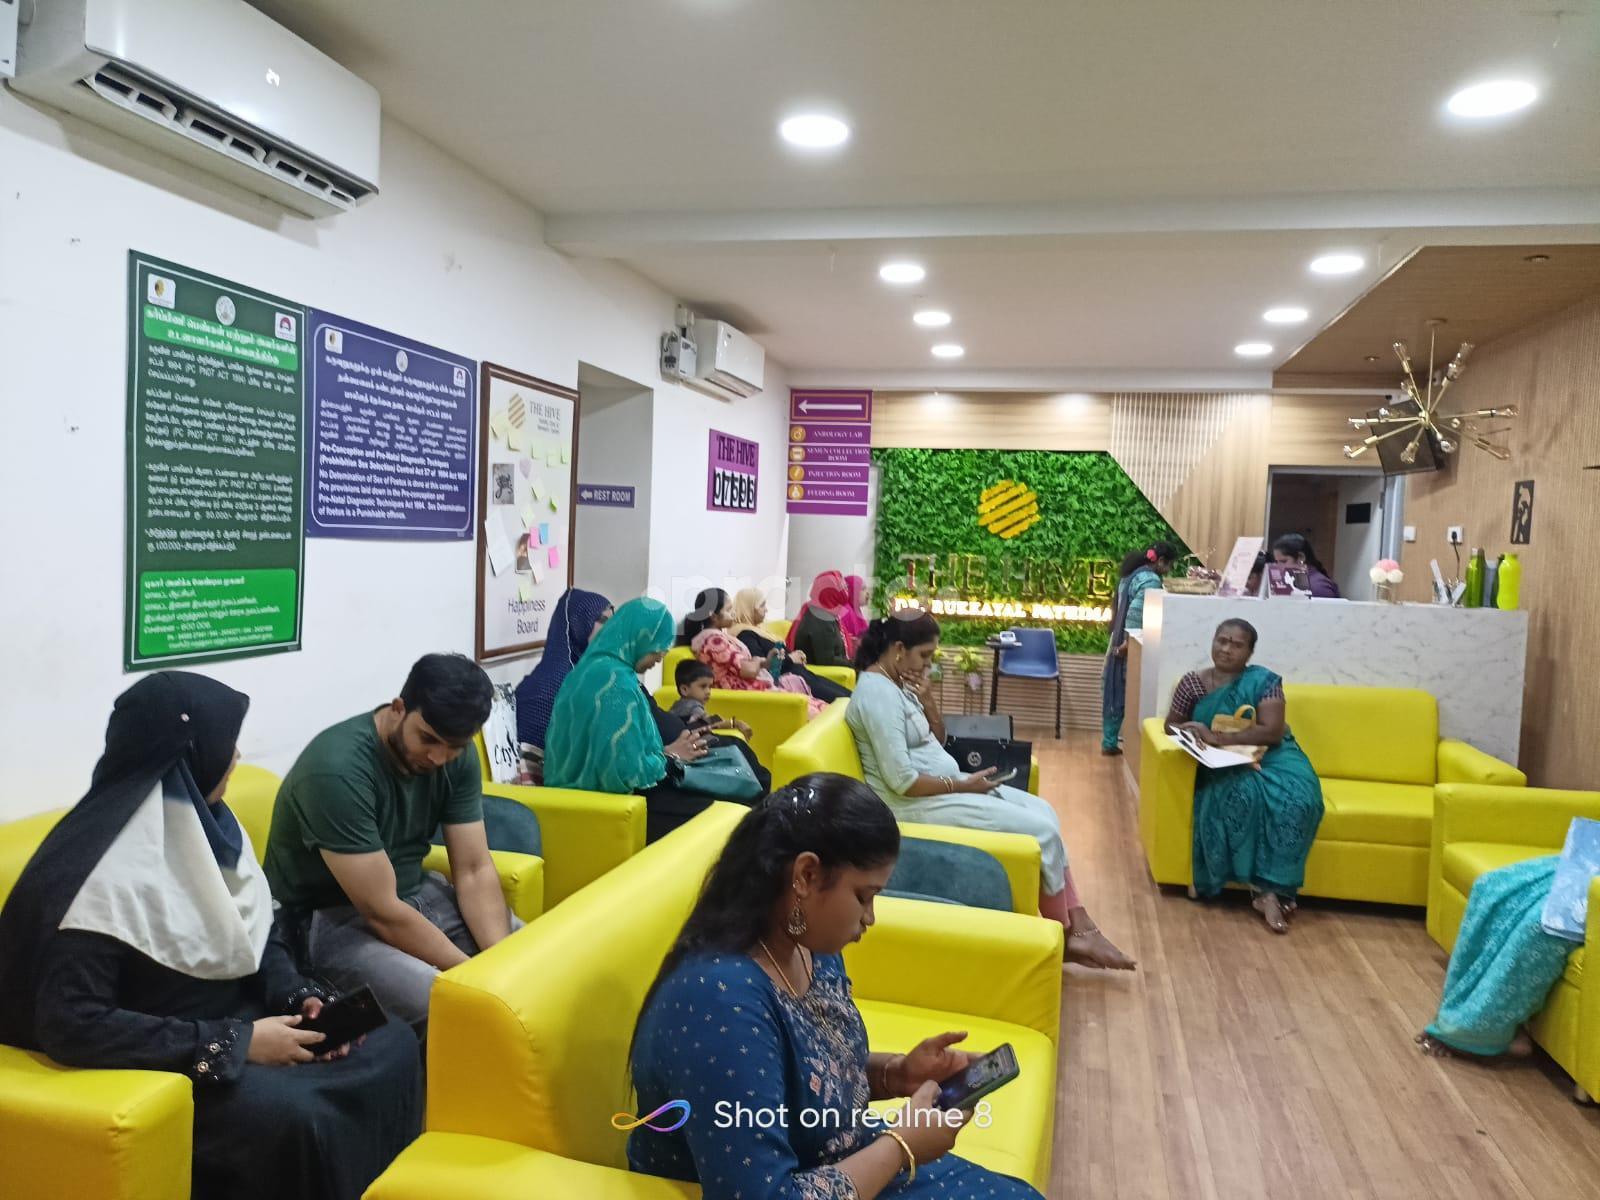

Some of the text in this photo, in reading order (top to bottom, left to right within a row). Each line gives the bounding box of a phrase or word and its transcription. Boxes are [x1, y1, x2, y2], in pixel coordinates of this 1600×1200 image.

[529, 400, 560, 420] THE HIVE
[716, 434, 756, 468] THE HIVE
[808, 470, 841, 478] INJECTION
[593, 490, 631, 502] REST ROOM
[898, 553, 1114, 600] THE HIVE
[508, 599, 546, 614] Happiness
[516, 618, 539, 635] Board
